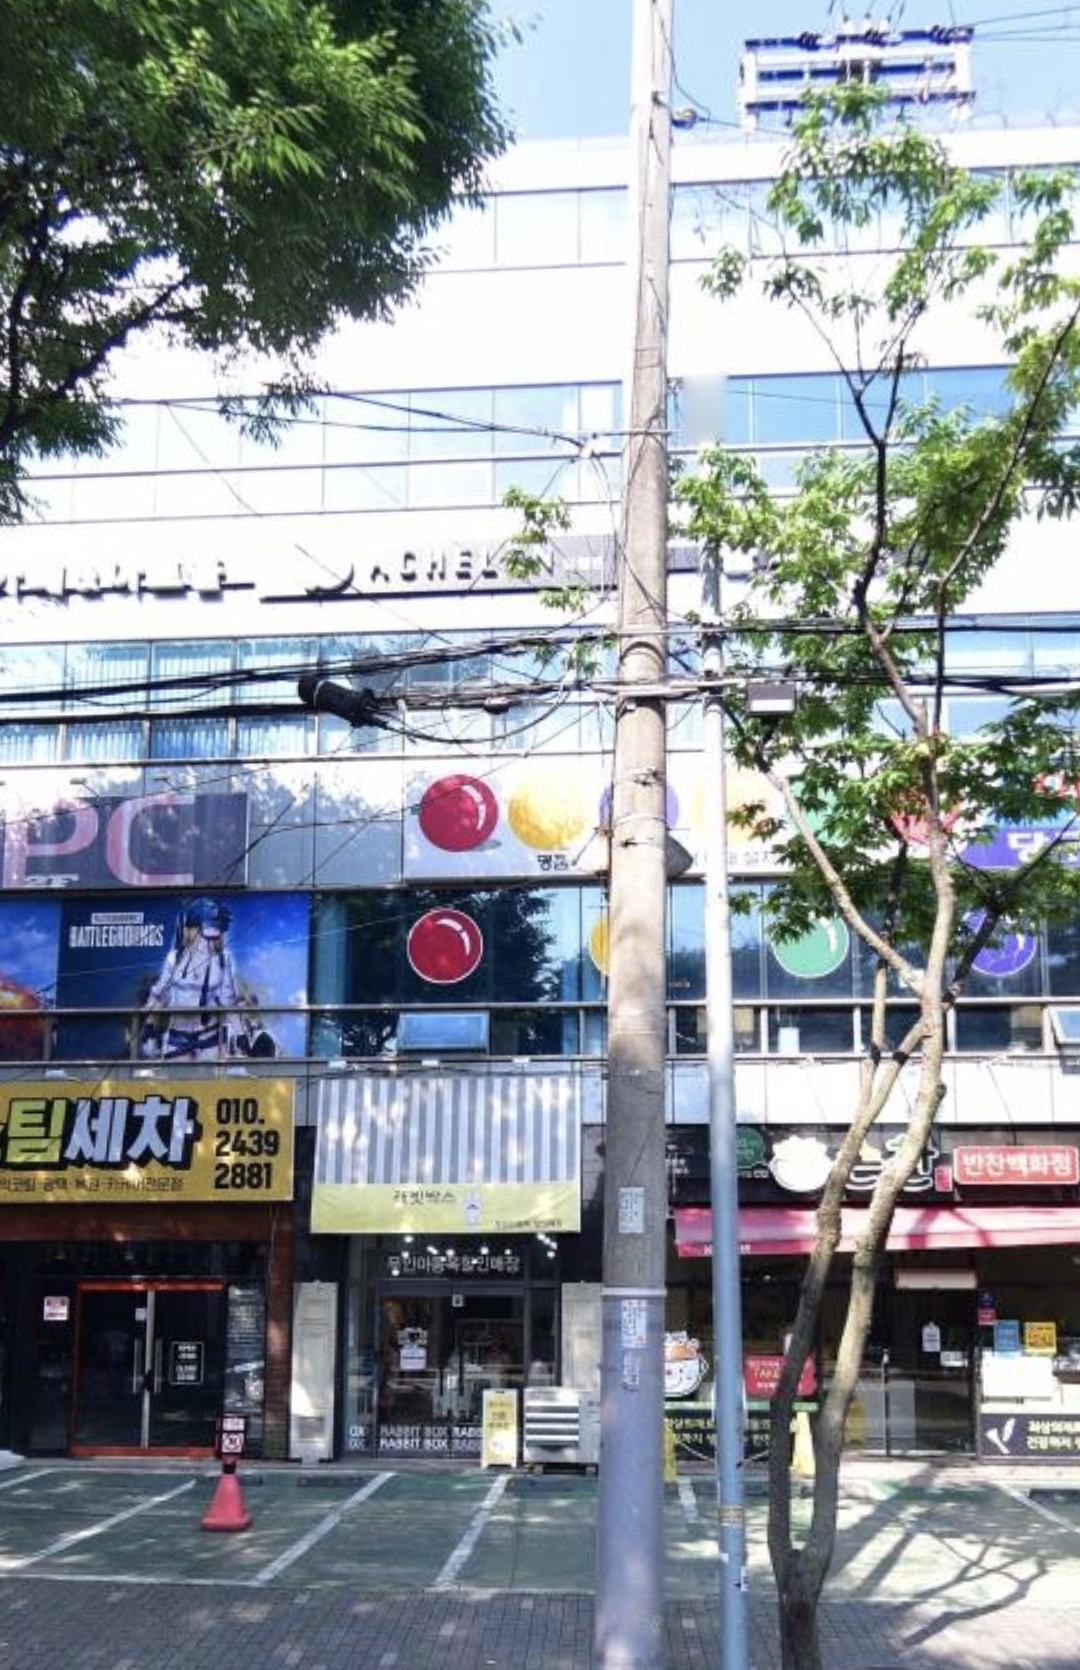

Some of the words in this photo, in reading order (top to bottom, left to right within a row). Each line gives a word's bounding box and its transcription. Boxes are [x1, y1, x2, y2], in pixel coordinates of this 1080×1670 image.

[3, 791, 195, 888] PC
[69, 924, 164, 948] BATTLEGROUNDS
[216, 1098, 264, 1125] 010.
[0, 1096, 201, 1170] 팀세차
[215, 1130, 279, 1157] 2439
[215, 1162, 272, 1189] 2881
[380, 1438, 420, 1449] RABBIT
